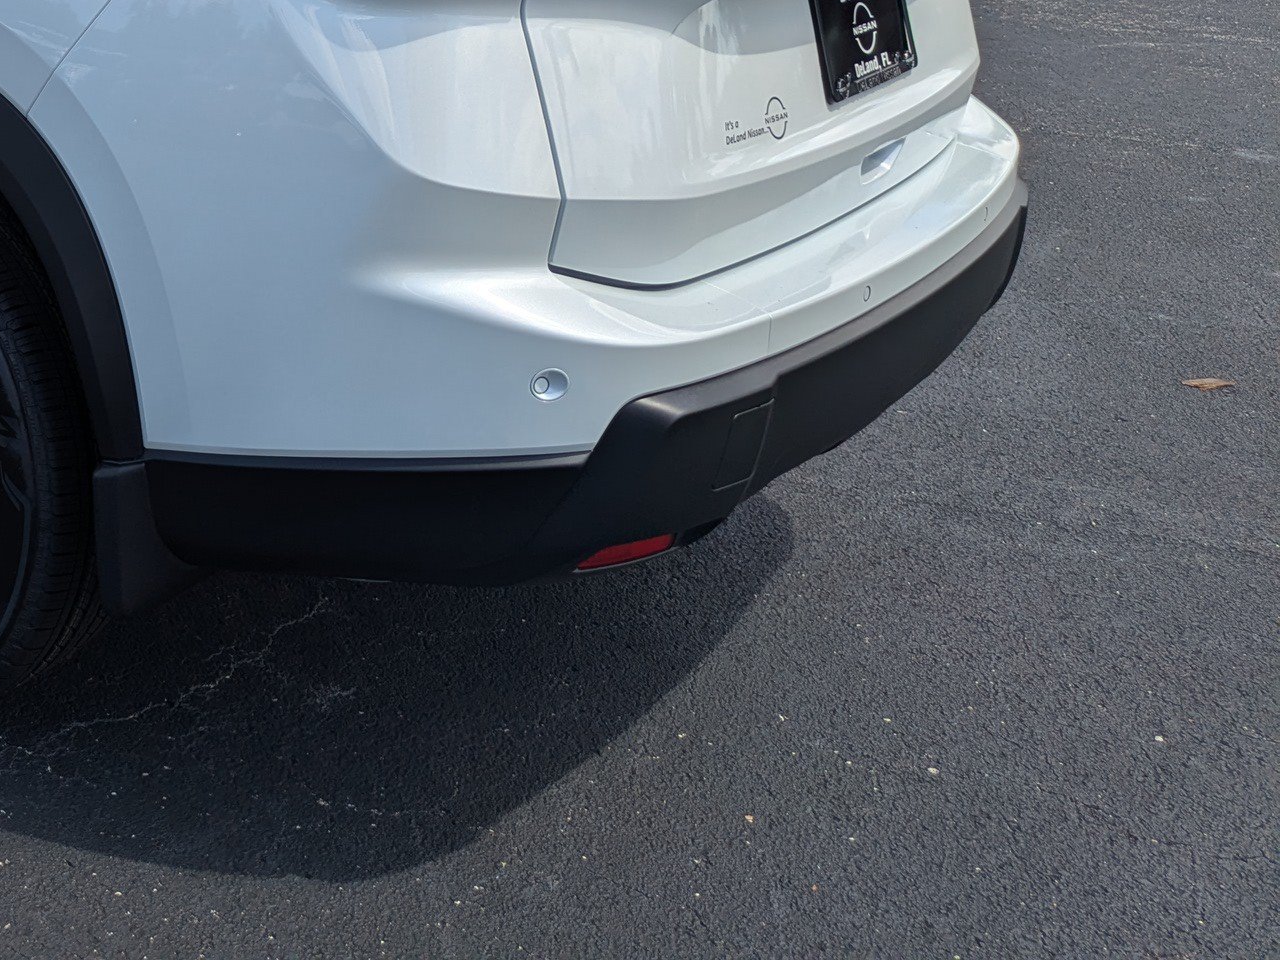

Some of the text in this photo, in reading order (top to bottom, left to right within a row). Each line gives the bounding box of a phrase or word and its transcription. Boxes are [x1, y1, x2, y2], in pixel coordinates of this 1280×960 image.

[852, 20, 878, 35] NISSAN
[854, 51, 892, 78] DeLand, FL
[764, 111, 788, 125] NISSAN
[725, 131, 747, 145] DeLand
